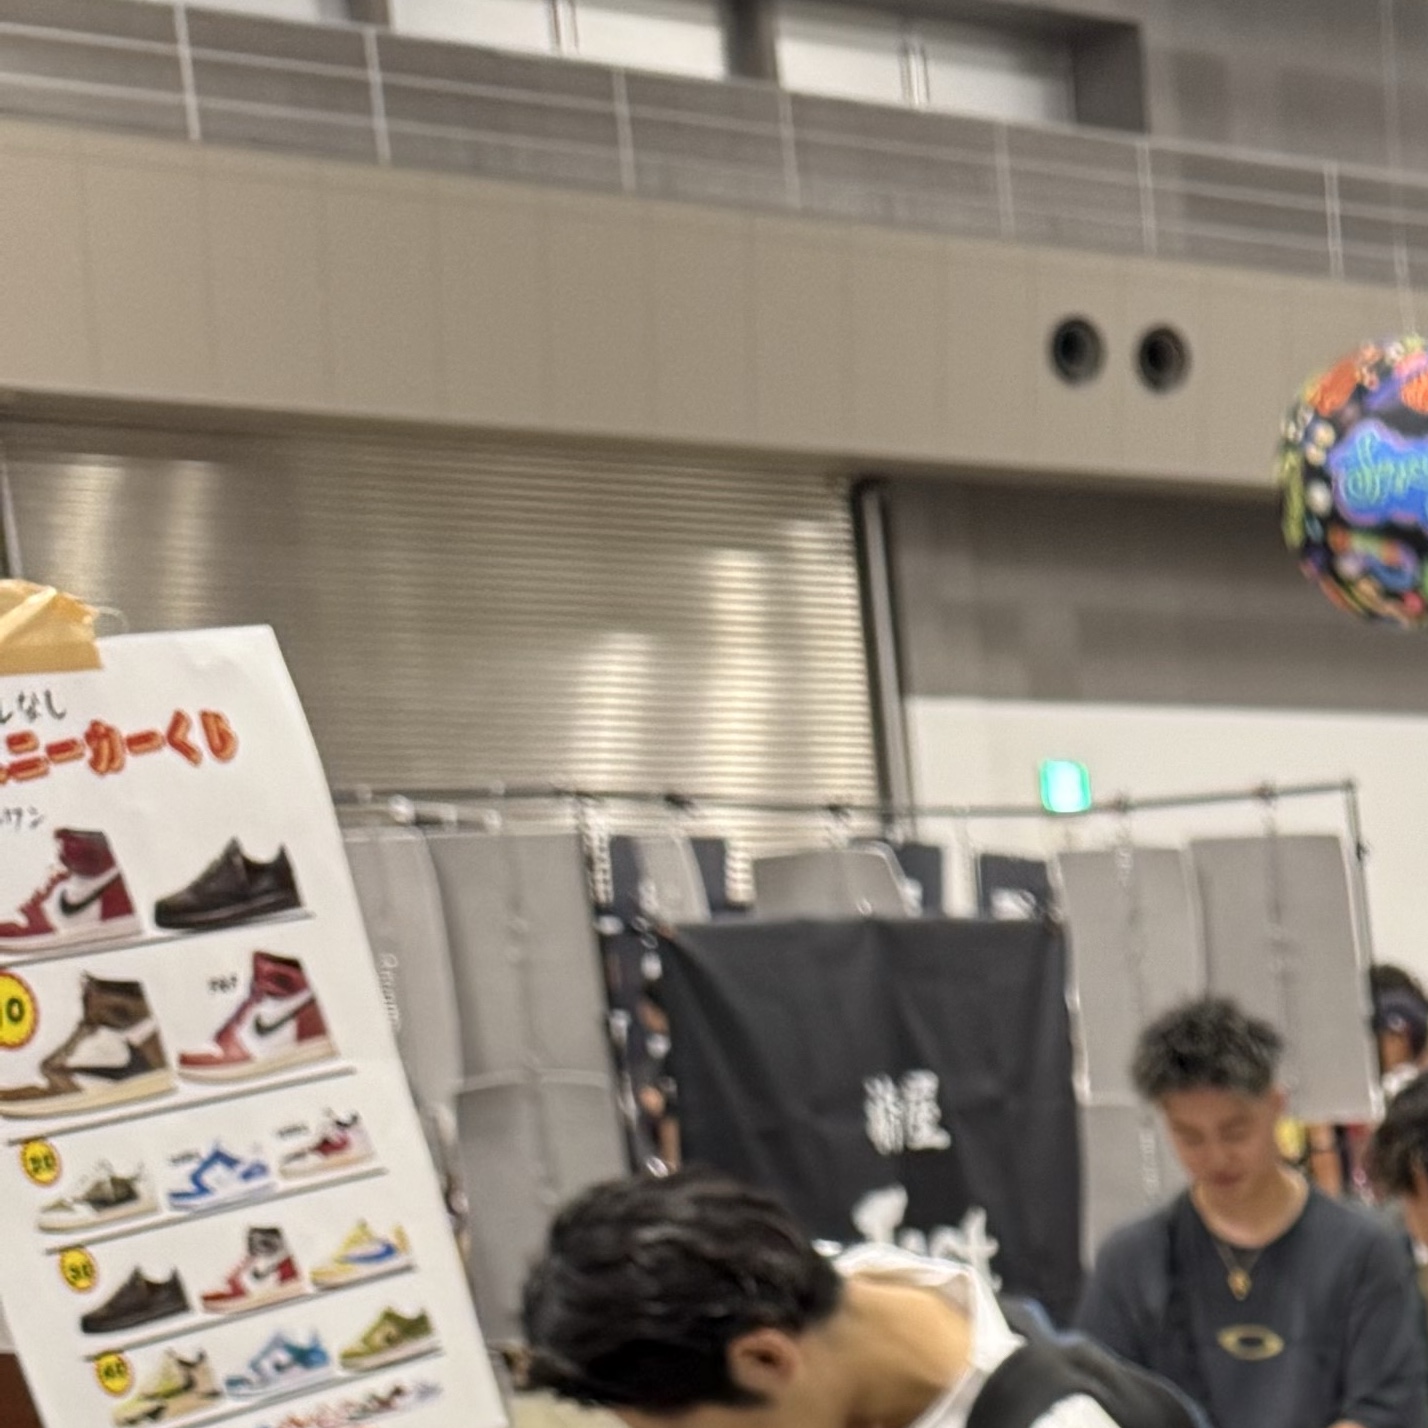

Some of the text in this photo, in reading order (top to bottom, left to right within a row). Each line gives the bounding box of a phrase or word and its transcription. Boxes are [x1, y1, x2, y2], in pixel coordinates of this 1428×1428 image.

[0, 708, 241, 786] ニーカーくじ
